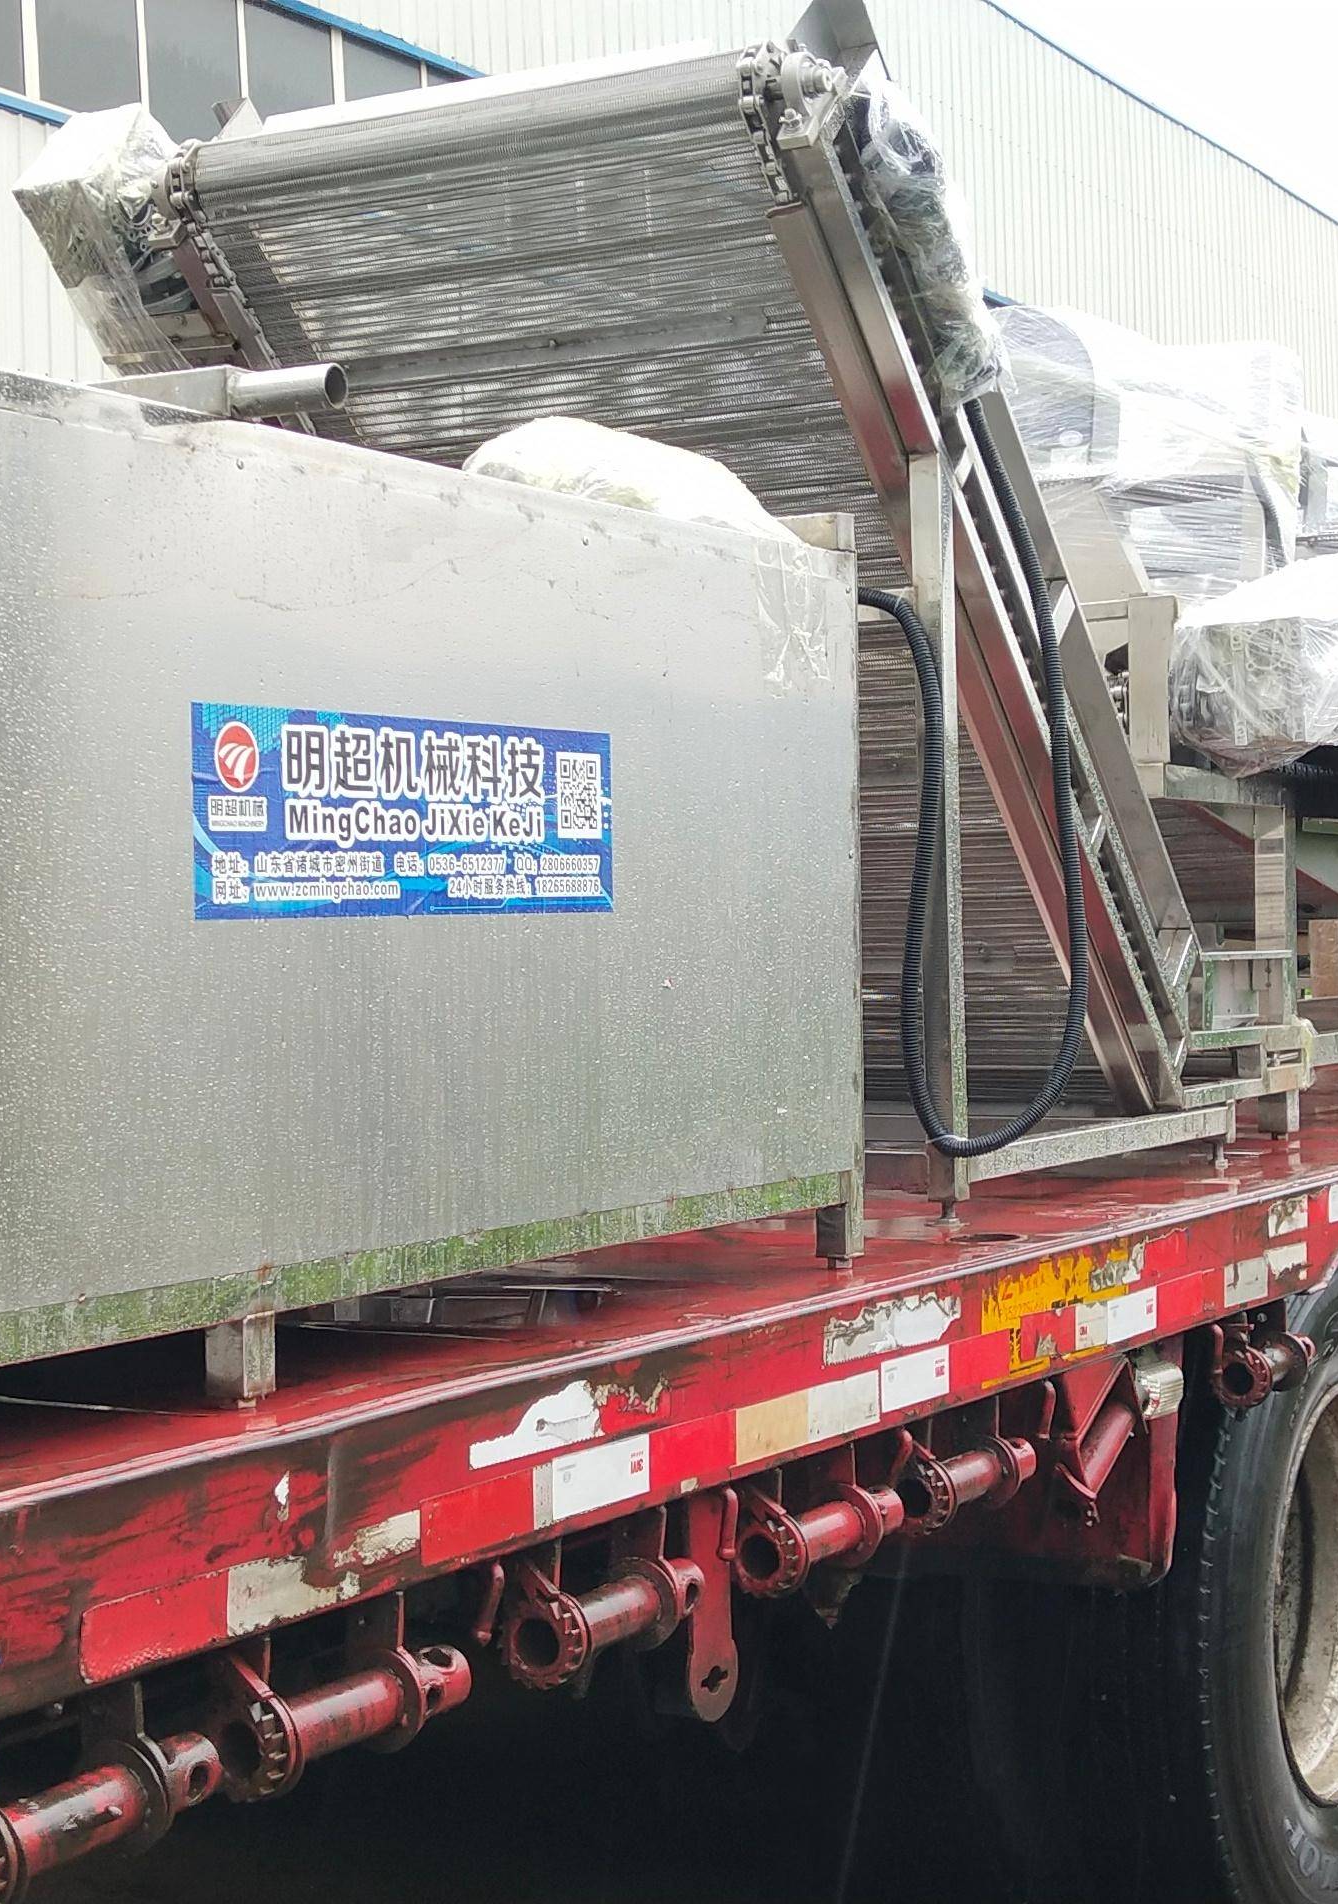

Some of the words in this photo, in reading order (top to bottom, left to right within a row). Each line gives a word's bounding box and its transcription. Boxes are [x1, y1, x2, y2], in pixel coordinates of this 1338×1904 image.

[286, 730, 542, 799] 明超机械科技
[210, 798, 265, 817] 明超机械
[289, 803, 417, 842] MingChao
[424, 807, 485, 837] JiXie
[492, 810, 542, 838] KeJi
